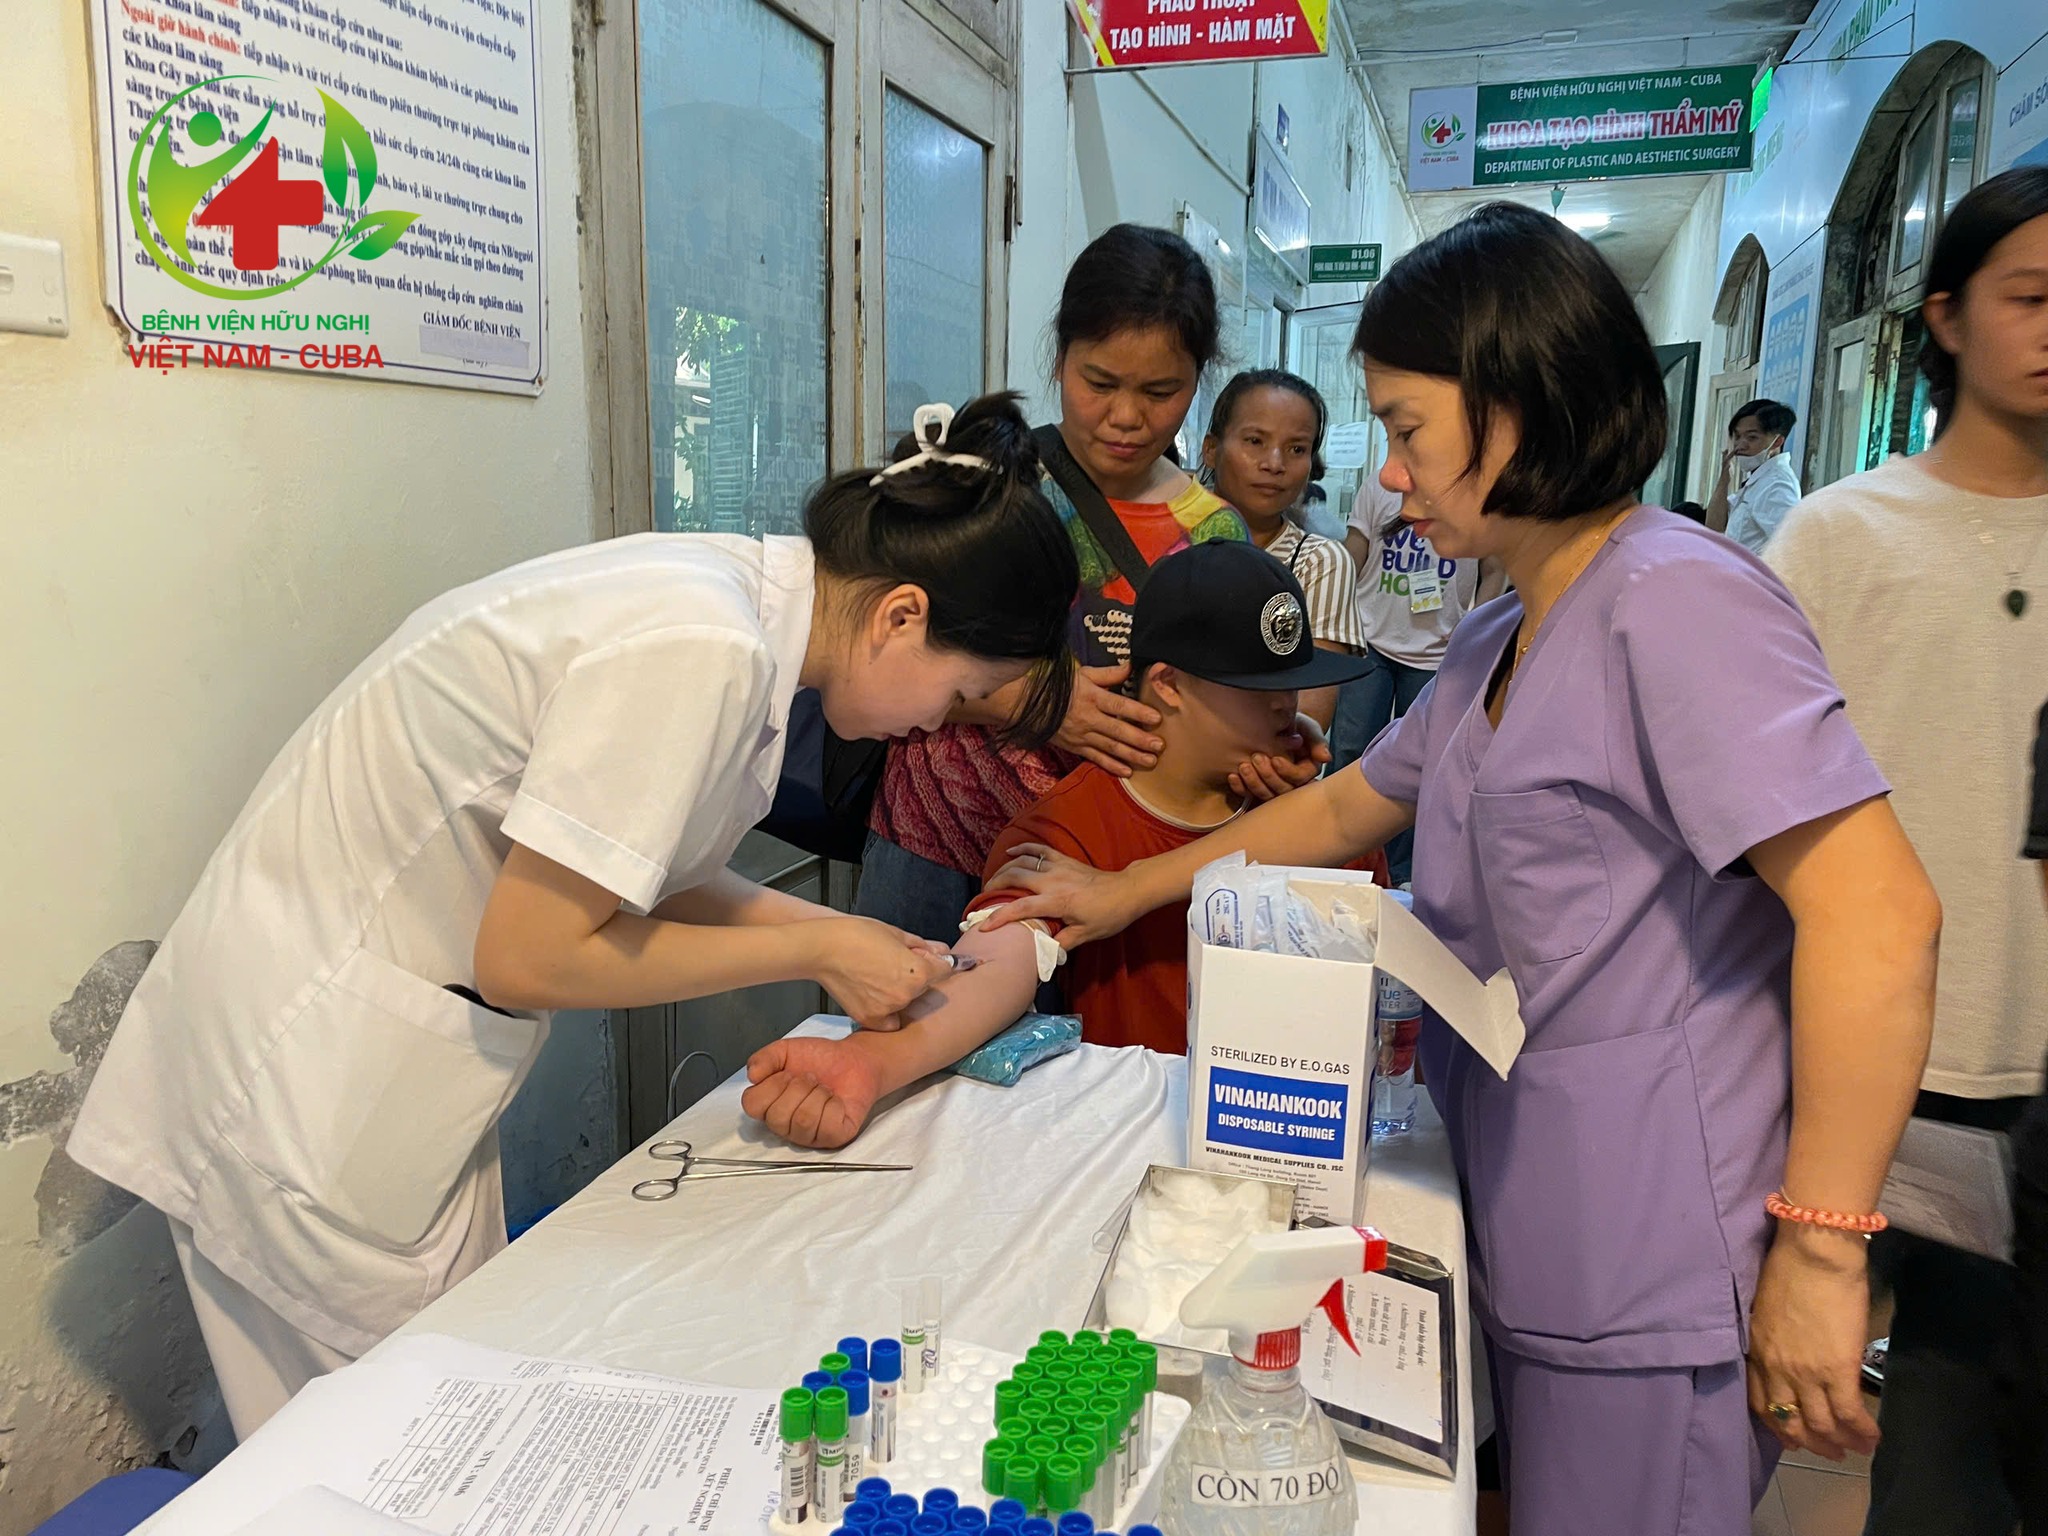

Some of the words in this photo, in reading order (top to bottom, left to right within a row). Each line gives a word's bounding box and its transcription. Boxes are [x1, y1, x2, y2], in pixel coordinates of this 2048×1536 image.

[122, 26, 142, 42] các
[144, 31, 172, 54] khoa
[174, 42, 196, 62] lâm
[331, 7, 346, 32] cấp
[349, 18, 365, 35] cứu
[386, 35, 403, 51] sau:
[418, 4, 432, 26] cấp
[434, 14, 449, 31] cứu
[450, 21, 460, 36] và
[461, 26, 475, 43] vận
[503, 41, 517, 61] cấp
[1109, 28, 1142, 54] TẠO
[1147, 21, 1191, 47] HÌNH
[1208, 16, 1251, 44] HÀM
[1255, 13, 1296, 44] MẶT
[123, 49, 156, 74] Khoa
[158, 60, 182, 86] Gây
[263, 7, 288, 29] nhận
[290, 17, 301, 32] và
[318, 28, 330, 44] trí
[331, 30, 347, 53] cấp
[349, 40, 366, 57] cứu
[368, 47, 379, 64] tại
[381, 51, 404, 72] Khoa
[405, 59, 428, 81] khám
[429, 69, 448, 89] bệnh
[450, 78, 459, 93] và
[460, 83, 473, 98] các
[474, 89, 497, 110] phòng
[498, 96, 518, 115] khám
[178, 18, 206, 43] hành
[243, 40, 262, 66] tiếp
[265, 51, 290, 74] nhận
[292, 61, 304, 77] và
[320, 71, 332, 87] trí
[333, 71, 350, 96] cấp
[351, 82, 368, 99] cứu
[369, 88, 388, 106] theo
[389, 95, 412, 115] phiên
[413, 104, 442, 129] thường
[472, 126, 495, 147] phòng
[496, 132, 517, 150] khám
[1510, 87, 1540, 102] BỆNH
[1542, 83, 1568, 99] VIỆN
[1597, 81, 1626, 94] NGHỊ
[1628, 77, 1652, 93] VIỆT
[1655, 76, 1682, 88] NAM
[1690, 73, 1722, 86] CUBA
[218, 102, 240, 123] viện
[1487, 119, 1547, 150] KHOA
[1548, 116, 1592, 150] TẠO
[1592, 107, 1647, 143] HÌNH
[1648, 98, 1708, 139] THẨM
[1709, 98, 1743, 134] MỸ
[404, 137, 418, 159] cấp
[420, 145, 435, 162] cứu
[436, 150, 461, 170] 24/24h
[462, 159, 480, 179] cùng
[481, 165, 493, 180] các
[494, 168, 512, 186] khoa
[1484, 159, 1550, 174] DEPARTMENT
[1552, 157, 1567, 170] OF
[1567, 153, 1609, 169] PLASTIC
[1609, 152, 1633, 166] AND
[1634, 148, 1691, 165] AESTHETIC
[1692, 146, 1741, 161] SURGERY
[434, 190, 443, 203] xe
[488, 204, 510, 225] chung
[511, 210, 524, 225] cho
[197, 260, 217, 278] các
[289, 254, 301, 271] và
[374, 274, 396, 290] quan
[447, 284, 461, 305] cấp
[423, 310, 450, 327] GIÁM
[452, 314, 473, 331] ĐỐC
[474, 319, 499, 336] BỆNH
[500, 321, 521, 339] VIỆN
[1211, 1045, 1277, 1066] STERILIZED
[1280, 1057, 1297, 1068] BY
[1300, 1059, 1351, 1075] E.O.GAS
[1214, 1083, 1343, 1119] VINAHANKOOK
[1218, 1113, 1285, 1135] DISPOSABLE
[1287, 1124, 1336, 1141] SYRINGE
[1205, 1146, 1252, 1160] VINAHANKOOK
[1253, 1154, 1282, 1165] MEDICAL
[1283, 1159, 1315, 1169] SUPPLIES
[469, 1449, 496, 1474] STT:
[714, 1467, 733, 1491] PHIẾU
[453, 1473, 477, 1497] 0106
[702, 1472, 718, 1488] XÉT
[1270, 1475, 1299, 1501] 70
[1306, 1462, 1340, 1496] ĐỘ
[685, 1489, 709, 1524] NGHIỆM
[697, 1509, 714, 1531] ĐỊNH
